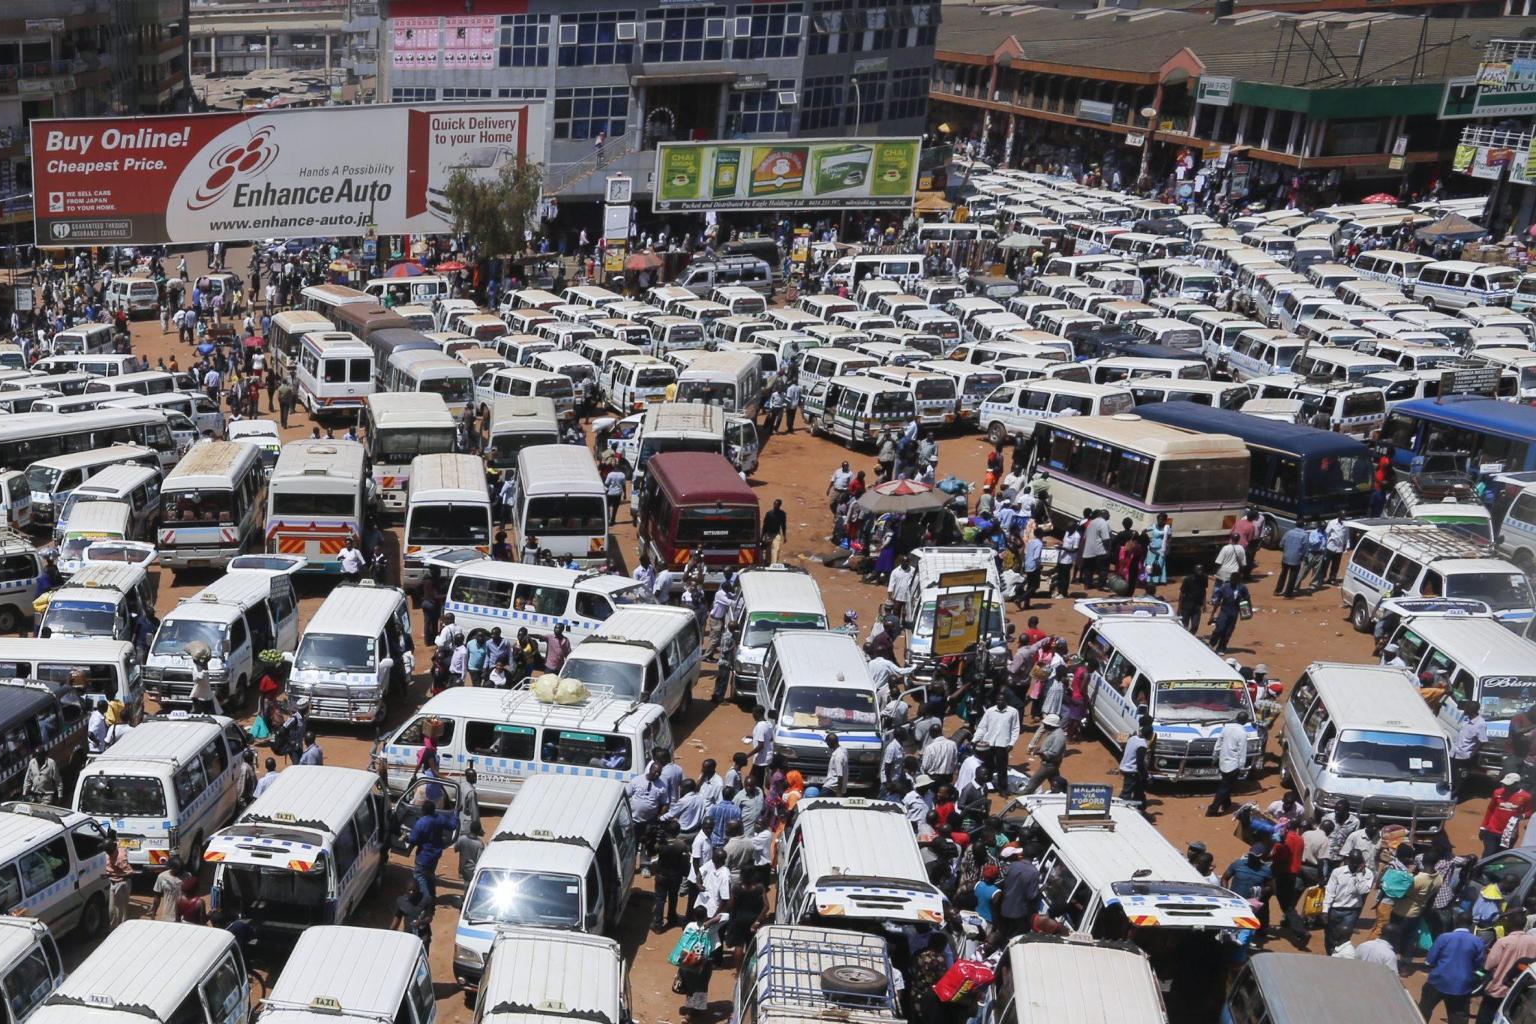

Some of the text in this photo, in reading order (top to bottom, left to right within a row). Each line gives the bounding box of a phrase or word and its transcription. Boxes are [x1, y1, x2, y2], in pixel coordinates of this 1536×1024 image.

[432, 117, 516, 133] Quick Delivery
[46, 126, 191, 155] Buy Online!
[435, 131, 513, 147] to your Home
[671, 153, 695, 162] CHAI
[47, 158, 167, 174] Cheapest Price.
[299, 164, 395, 178] Hands A Possibility
[71, 222, 129, 231] GUARANTEED THROUGH
[209, 212, 373, 231] www.enhance-auto.jp
[277, 812, 292, 820] TAXI
[91, 994, 109, 1004] TAXI
[315, 997, 336, 1007] TAXI
